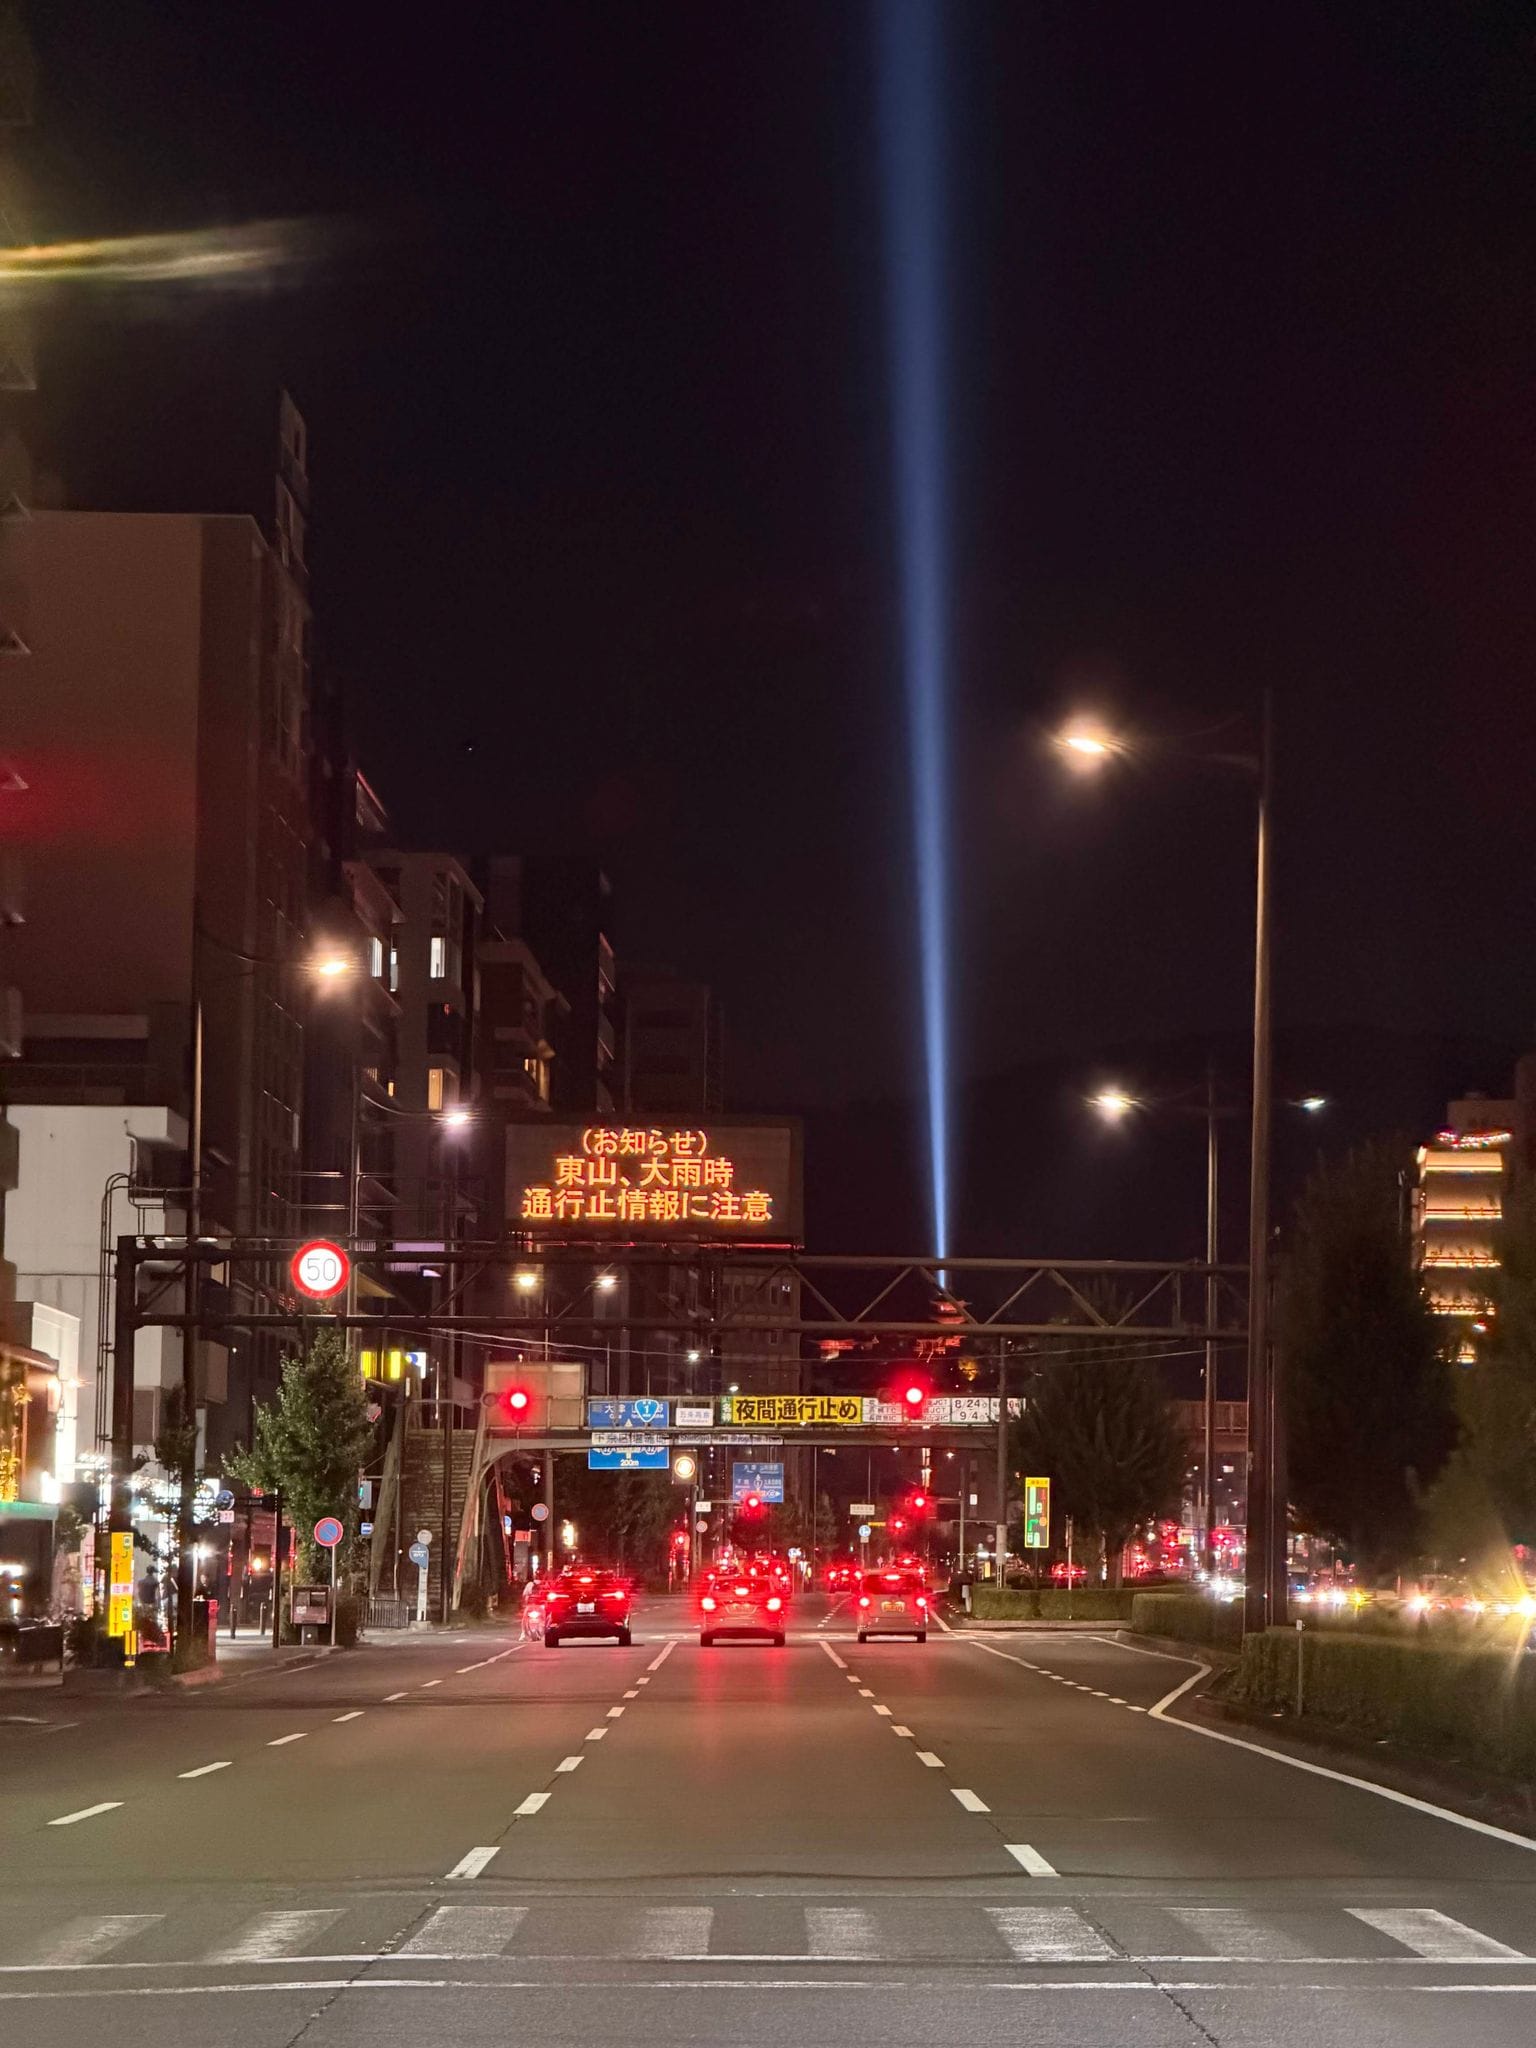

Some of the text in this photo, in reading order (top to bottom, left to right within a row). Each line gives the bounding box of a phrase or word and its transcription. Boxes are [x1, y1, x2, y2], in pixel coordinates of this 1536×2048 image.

[555, 1155, 734, 1188] 東山、大雨時
[521, 1188, 773, 1221] 通行止情報に注意
[307, 1257, 337, 1281] 50
[736, 1398, 858, 1420] 夜間通行止め
